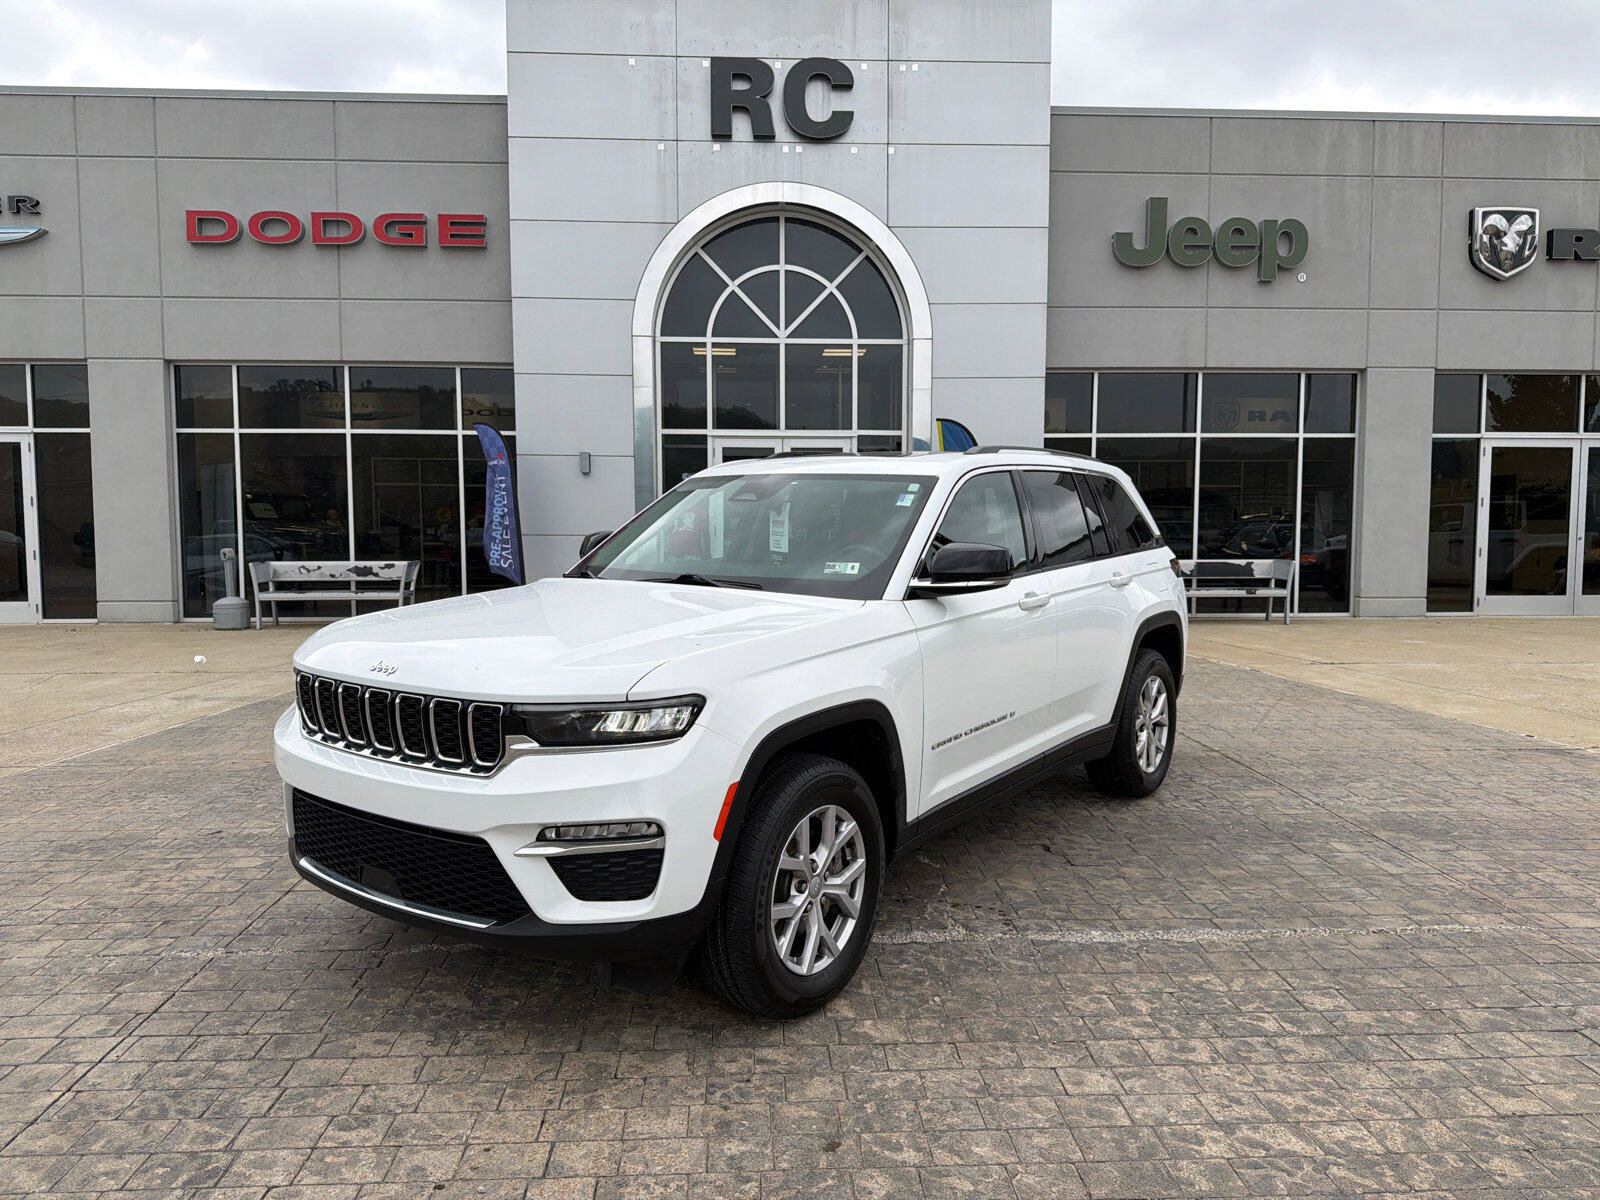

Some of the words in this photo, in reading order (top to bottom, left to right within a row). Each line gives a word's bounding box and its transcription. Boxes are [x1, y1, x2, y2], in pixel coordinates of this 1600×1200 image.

[710, 57, 854, 141] RC
[0, 194, 41, 215] R
[185, 209, 488, 249] DODGE
[1112, 196, 1310, 283] Jeep
[489, 476, 504, 567] PRE-APPROVA
[369, 660, 398, 677] Jeep
